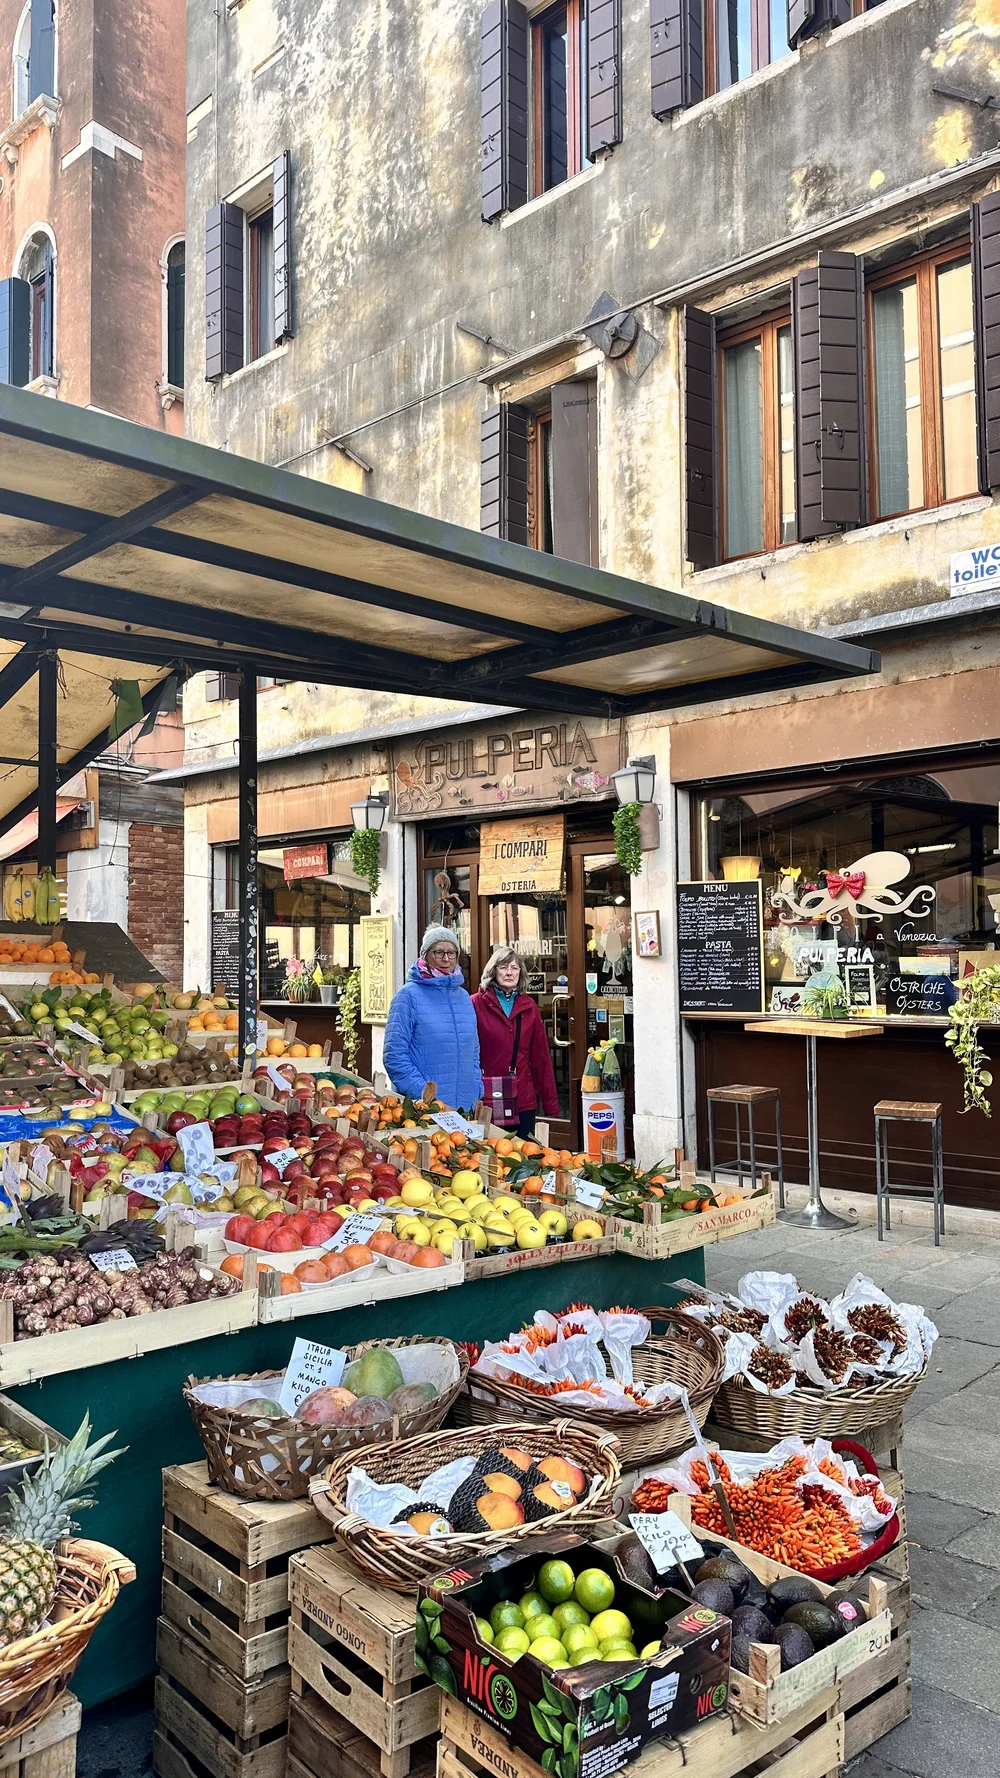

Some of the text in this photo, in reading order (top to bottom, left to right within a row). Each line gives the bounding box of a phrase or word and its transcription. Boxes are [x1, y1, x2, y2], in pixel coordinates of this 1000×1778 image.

[953, 563, 1000, 583] toile
[424, 720, 598, 785] PULPERIA
[500, 839, 548, 860] COMPARI
[293, 855, 324, 869] COMPARI
[501, 880, 537, 892] OSTERIA
[703, 884, 729, 893] MENU
[893, 921, 948, 942] Venezia
[705, 940, 732, 950] PASTA
[797, 947, 875, 963] PULPERIA
[889, 976, 946, 995] OSTRICHE
[896, 995, 942, 1014] OYSTERS
[587, 1111, 615, 1120] PEPSI
[697, 1217, 716, 1232] SAN
[718, 1208, 751, 1225] MARCO
[506, 1243, 593, 1268] JOLLY FRUTTA
[307, 1343, 332, 1356] ITALIA
[303, 1352, 333, 1367] SICILIA
[291, 1381, 311, 1394] KILO
[297, 1372, 327, 1387] MANGO
[294, 1394, 302, 1408] €
[632, 1516, 659, 1525] PERU
[636, 1525, 649, 1534] CT
[641, 1529, 671, 1543] KILO
[302, 1595, 335, 1629] ANDREA
[336, 1623, 367, 1656] LONGO
[463, 1647, 518, 1720] NICO
[696, 1684, 727, 1718] NICO
[648, 1701, 674, 1721] SELECTED
[470, 1732, 519, 1778] ANDREA
